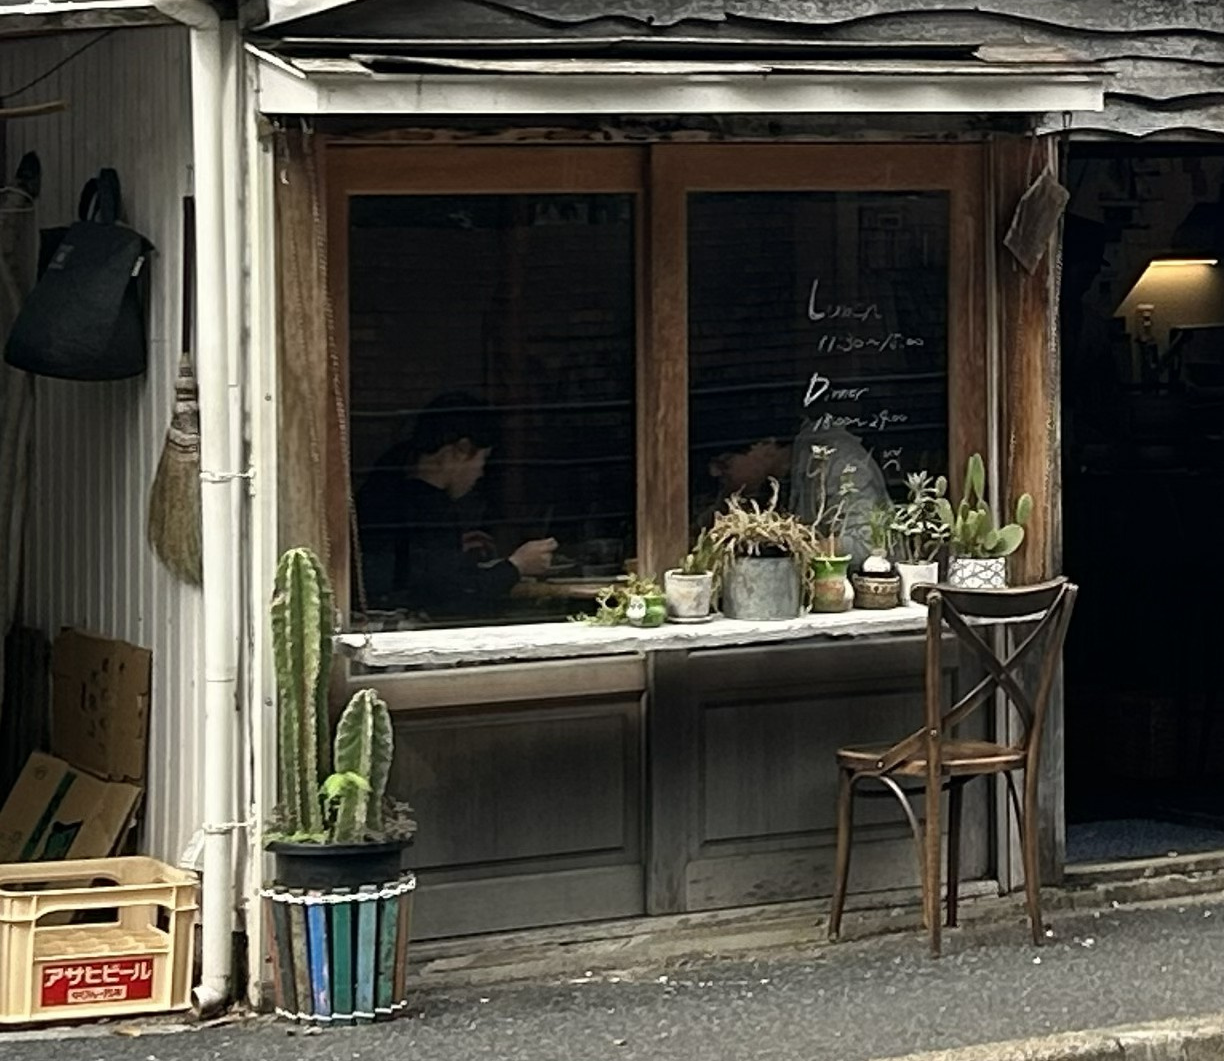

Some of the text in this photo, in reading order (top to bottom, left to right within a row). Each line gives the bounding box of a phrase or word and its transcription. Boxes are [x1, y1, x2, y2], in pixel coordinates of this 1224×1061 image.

[44, 961, 152, 988] アサヒビール
